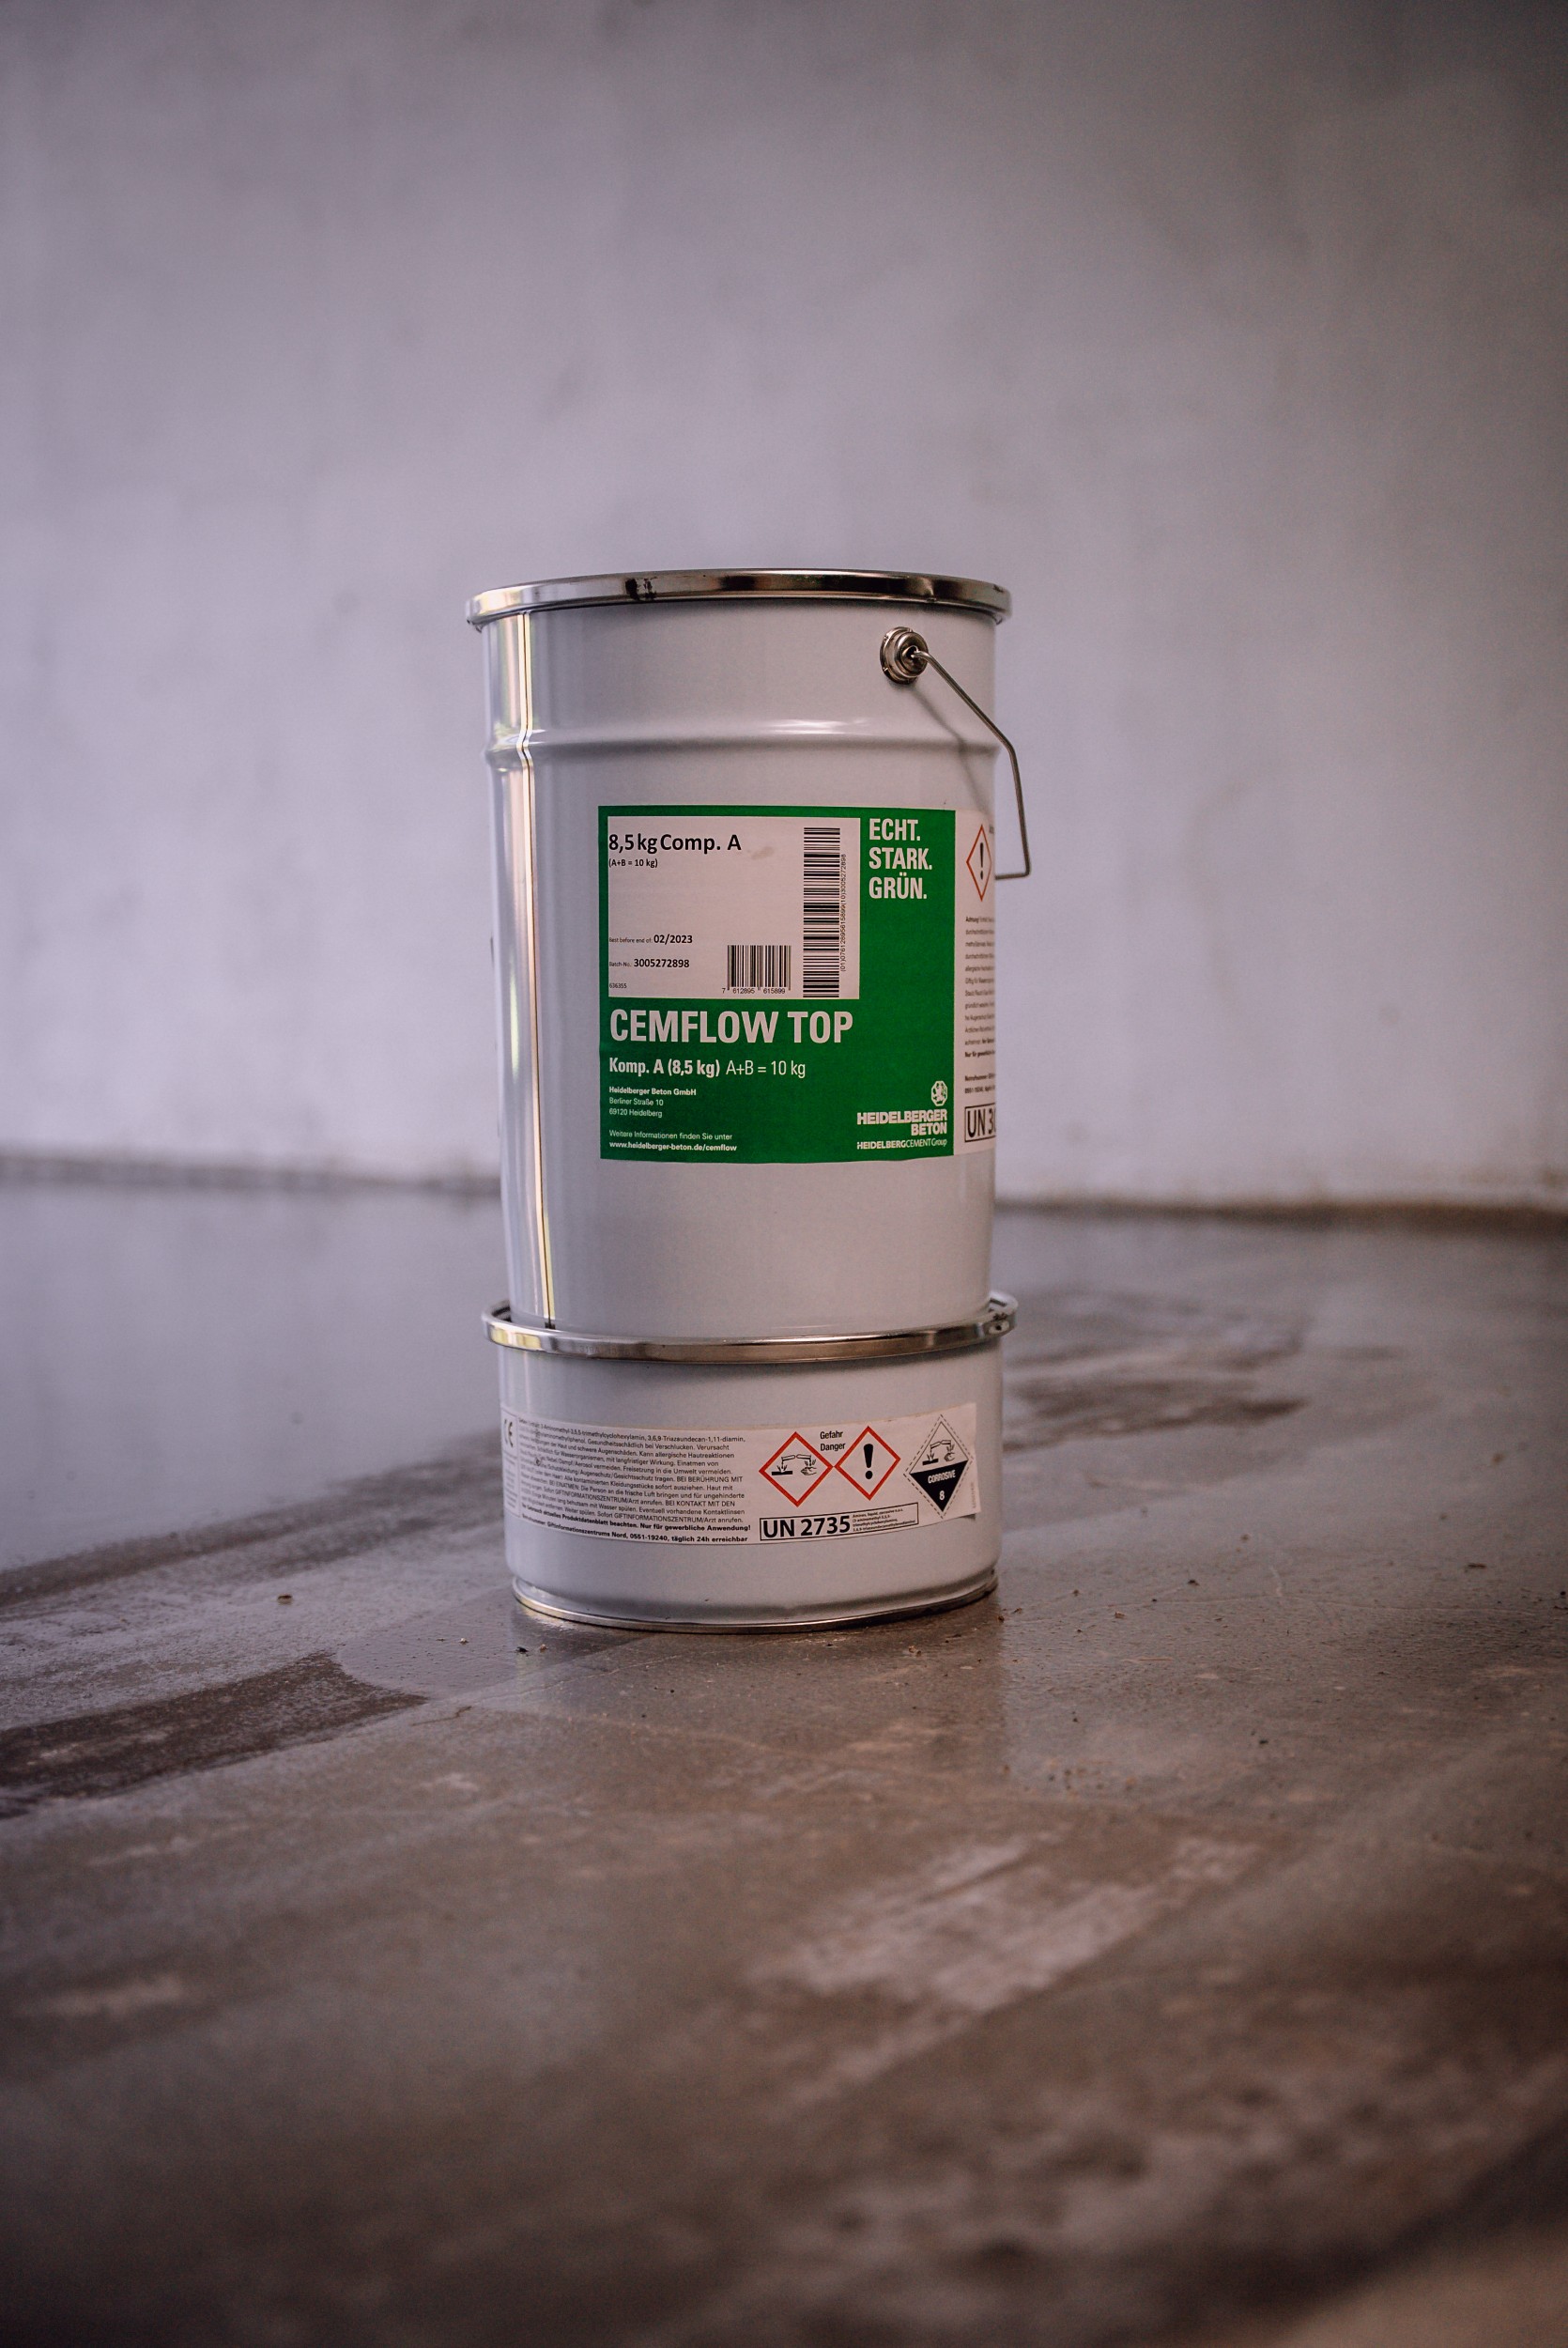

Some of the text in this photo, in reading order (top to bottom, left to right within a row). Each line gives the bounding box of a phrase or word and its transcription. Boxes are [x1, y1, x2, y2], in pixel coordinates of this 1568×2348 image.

[869, 818, 921, 842] ECHT.
[608, 833, 742, 855] 8,5 kg Comp. A
[608, 858, 626, 868] (A+B
[635, 858, 644, 867] 10
[646, 858, 658, 869] kg)
[869, 846, 932, 870] STARK.
[869, 872, 928, 900] GRÜN.
[653, 935, 693, 945] 02/2023
[634, 958, 690, 968] 3005272898
[610, 1009, 853, 1043] CEMFLOW TOP
[609, 1058, 650, 1076] Komp.
[653, 1059, 665, 1074] A
[668, 1058, 693, 1077] (8,5
[697, 1059, 720, 1078] kg)
[726, 1060, 754, 1075] A+B
[771, 1060, 787, 1075] 10
[791, 1060, 806, 1079] kg
[609, 1086, 650, 1096] Heidelberger
[633, 1098, 654, 1106] Straße
[609, 1107, 663, 1118] 69120 Heidelberg
[856, 1108, 947, 1125] HEIDELBERGER
[911, 1122, 947, 1136] BETON
[967, 1109, 986, 1138] UN
[634, 1131, 678, 1139] Informationen
[609, 1141, 738, 1151] www.heidelberger-beton.de/cemflow
[820, 1430, 843, 1440] Gefahr
[598, 1447, 638, 1456] Augenschäden.
[820, 1442, 846, 1452] Danger
[594, 1463, 623, 1472] vermeiden.
[650, 1459, 675, 1467] Wirkung.
[928, 1469, 956, 1484] CORROSIVE
[610, 1480, 653, 1490] Kleidungsstücke
[656, 1491, 680, 1500] bringen
[939, 1490, 945, 1501] 8
[561, 1514, 608, 1525] Produktdatenblatt
[614, 1512, 716, 1523] GIFTINFORMATIONSZENTRUM/Arzt
[762, 1519, 795, 1538] UN
[800, 1515, 851, 1537] 2735
[630, 1533, 670, 1541] 0551-19240,
